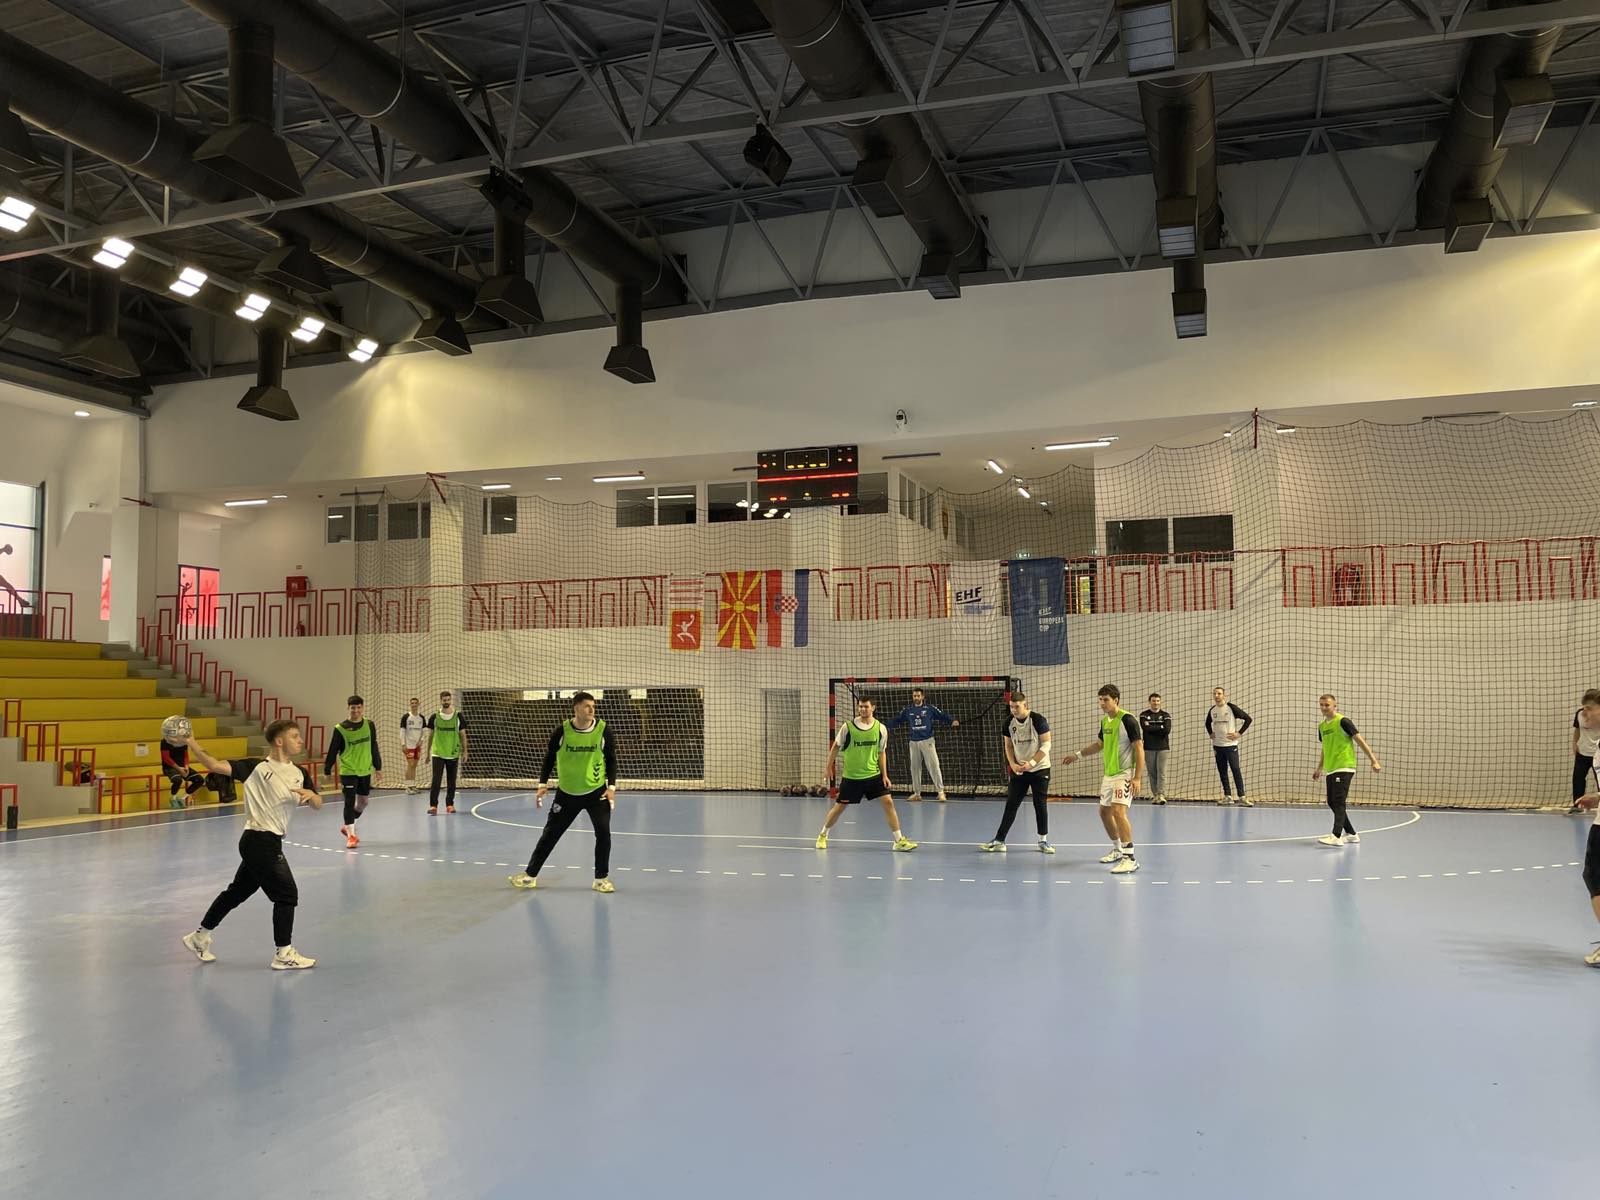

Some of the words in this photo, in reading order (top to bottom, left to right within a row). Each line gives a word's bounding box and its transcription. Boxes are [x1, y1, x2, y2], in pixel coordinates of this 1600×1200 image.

[955, 586, 982, 602] EHF
[566, 744, 597, 752] hummel
[1115, 789, 1123, 799] 18
